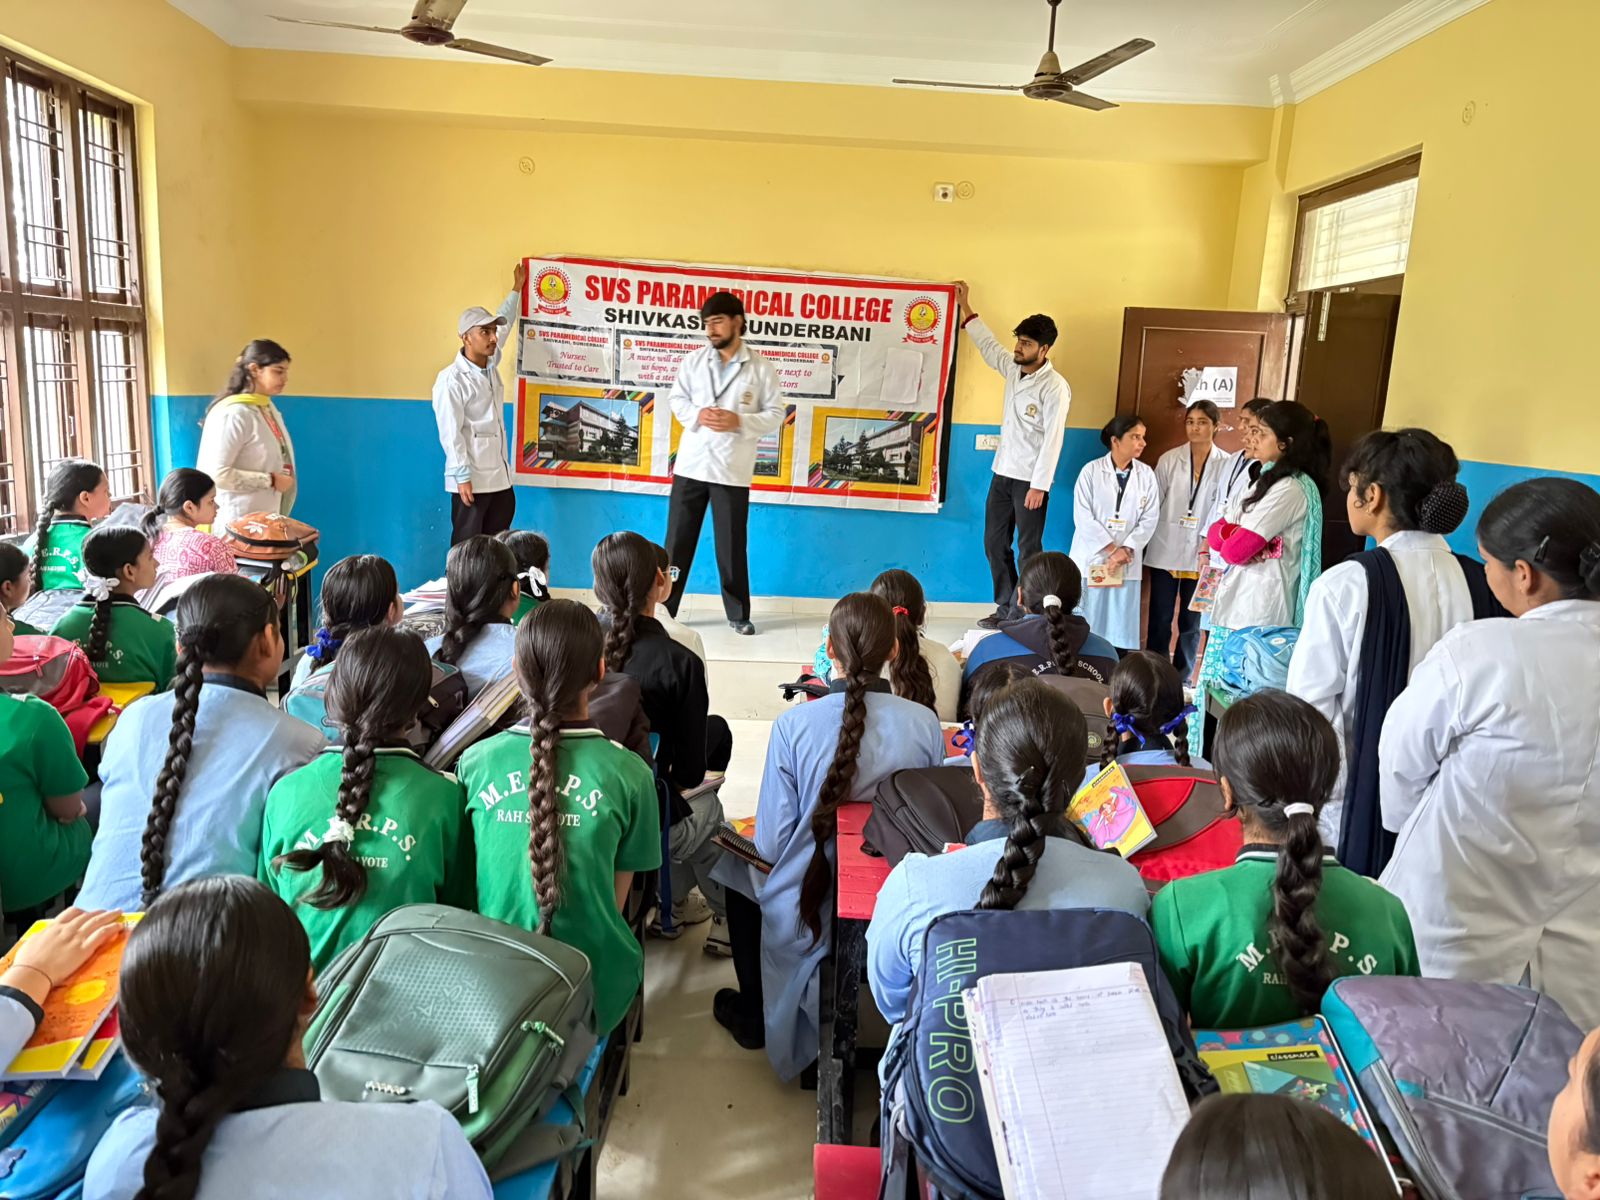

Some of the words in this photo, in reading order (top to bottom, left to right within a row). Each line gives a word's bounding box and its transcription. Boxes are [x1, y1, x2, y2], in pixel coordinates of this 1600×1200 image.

[585, 274, 631, 303] SVS
[800, 293, 893, 323] COLLEGE
[550, 331, 587, 342] PARAMEDICAL
[587, 336, 609, 344] COLLEGE
[646, 340, 683, 349] PARAMEDICAL
[559, 351, 586, 361] Nurses:
[627, 352, 635, 361] A
[657, 354, 672, 362] will
[761, 349, 796, 358] PARAMEDICAL
[797, 351, 819, 359] COLLEGE
[547, 360, 574, 370] Trusted
[574, 363, 582, 371] to
[583, 365, 599, 373] Care
[651, 362, 669, 373] hope,
[638, 371, 654, 380] with
[784, 369, 802, 377] next
[803, 369, 812, 377] to
[1213, 378, 1234, 392] (A)
[1077, 660, 1104, 684] SCHOOL
[497, 809, 524, 823] RAH
[928, 938, 977, 1123] HI-PRO
[1270, 1051, 1316, 1061] classmate
